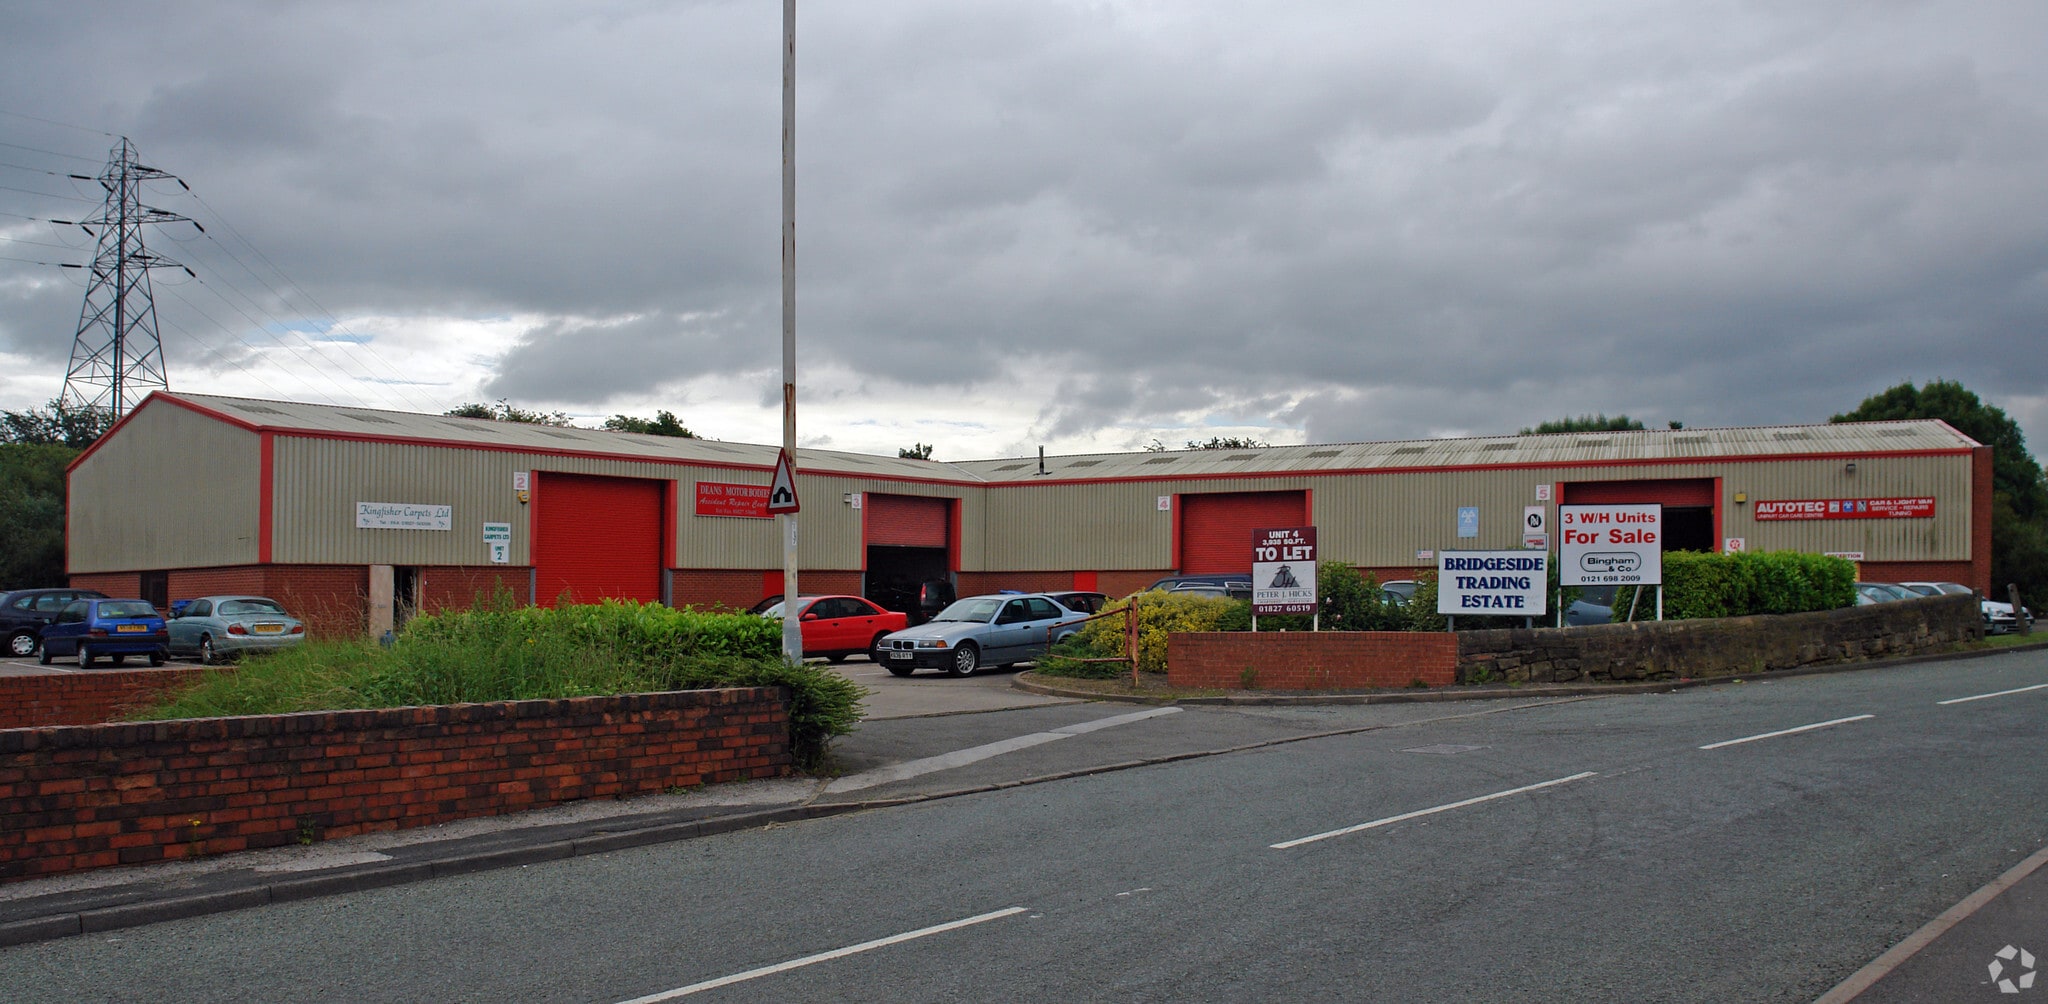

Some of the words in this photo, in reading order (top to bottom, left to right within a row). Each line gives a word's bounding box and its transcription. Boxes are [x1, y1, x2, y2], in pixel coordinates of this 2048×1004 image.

[516, 477, 525, 488] 2
[700, 485, 722, 495] DEANS
[1539, 489, 1548, 499] 5
[698, 497, 726, 505] Accident
[729, 498, 750, 507] Repair
[853, 497, 860, 507] 3
[1159, 500, 1169, 509] 4
[1757, 501, 1826, 513] AUTOTEC
[359, 504, 402, 519] Kingfisher
[403, 506, 432, 520] Carpets
[434, 507, 449, 518] Ltd
[1564, 513, 1574, 524] 3
[1580, 512, 1610, 524] W/H
[1615, 512, 1656, 523] Units
[1269, 530, 1290, 539] UNIT
[1292, 530, 1299, 538] 4
[1564, 529, 1600, 545] For
[1608, 528, 1656, 544] Sale
[496, 551, 503, 561] 2
[1255, 546, 1278, 561] TO
[1282, 545, 1313, 560] LET
[1444, 557, 1544, 571] BRIDGESIDE
[1587, 557, 1635, 566] Bingham
[1455, 576, 1531, 590] TRADING
[1256, 591, 1280, 599] PETER
[1288, 589, 1313, 598] HICKS
[1461, 595, 1525, 608] ESTATE
[1286, 604, 1311, 612] 60519
